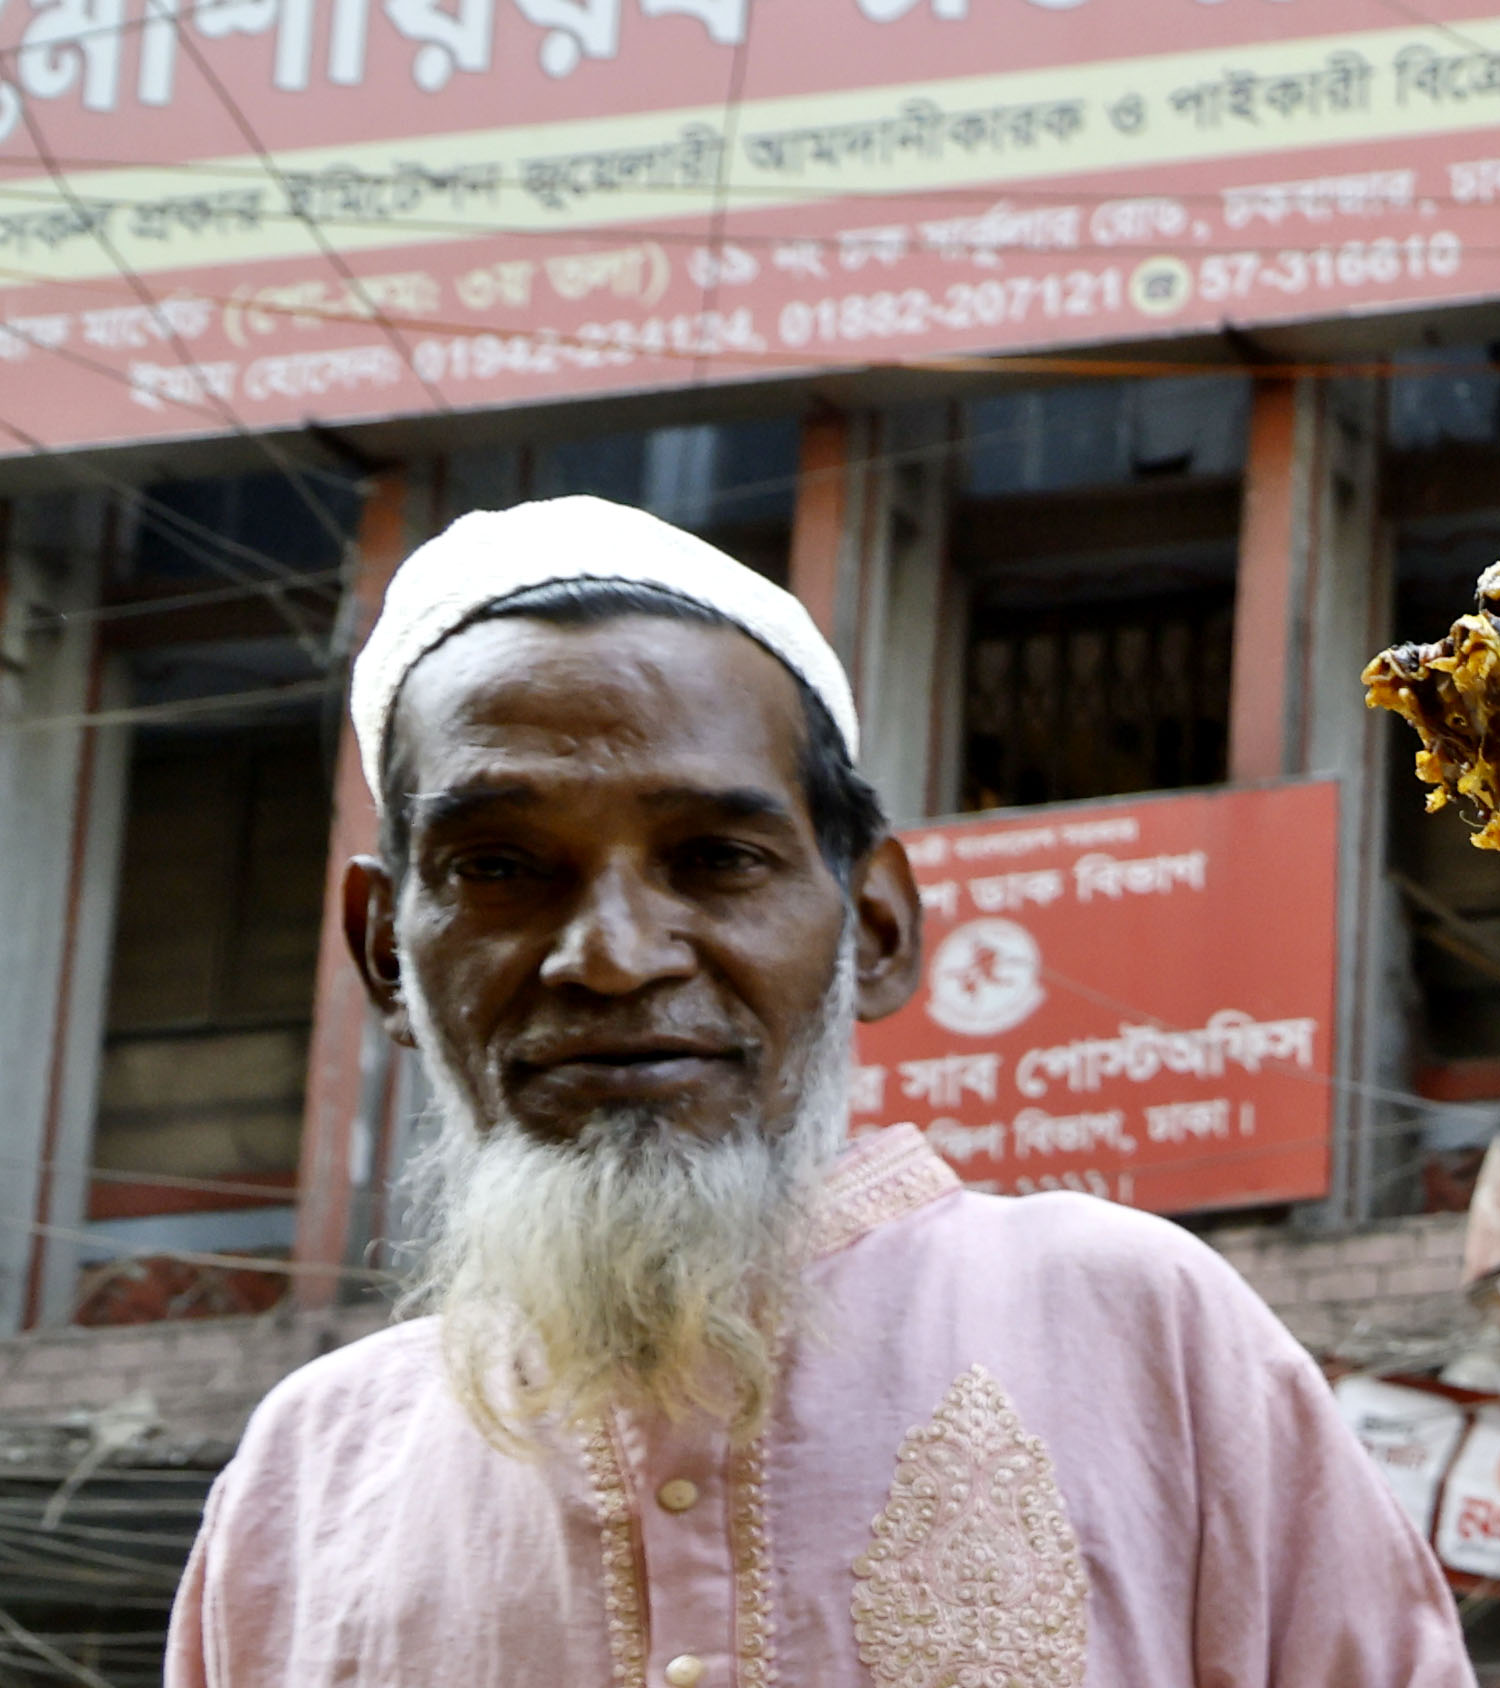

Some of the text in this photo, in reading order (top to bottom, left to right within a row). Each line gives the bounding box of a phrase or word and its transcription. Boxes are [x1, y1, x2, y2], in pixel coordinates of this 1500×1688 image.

[1106, 97, 1145, 136] ও
[1170, 49, 1375, 124] পাইকারী
[969, 850, 1208, 913] ডাক বিভাগ
[900, 1052, 1003, 1108] সাব
